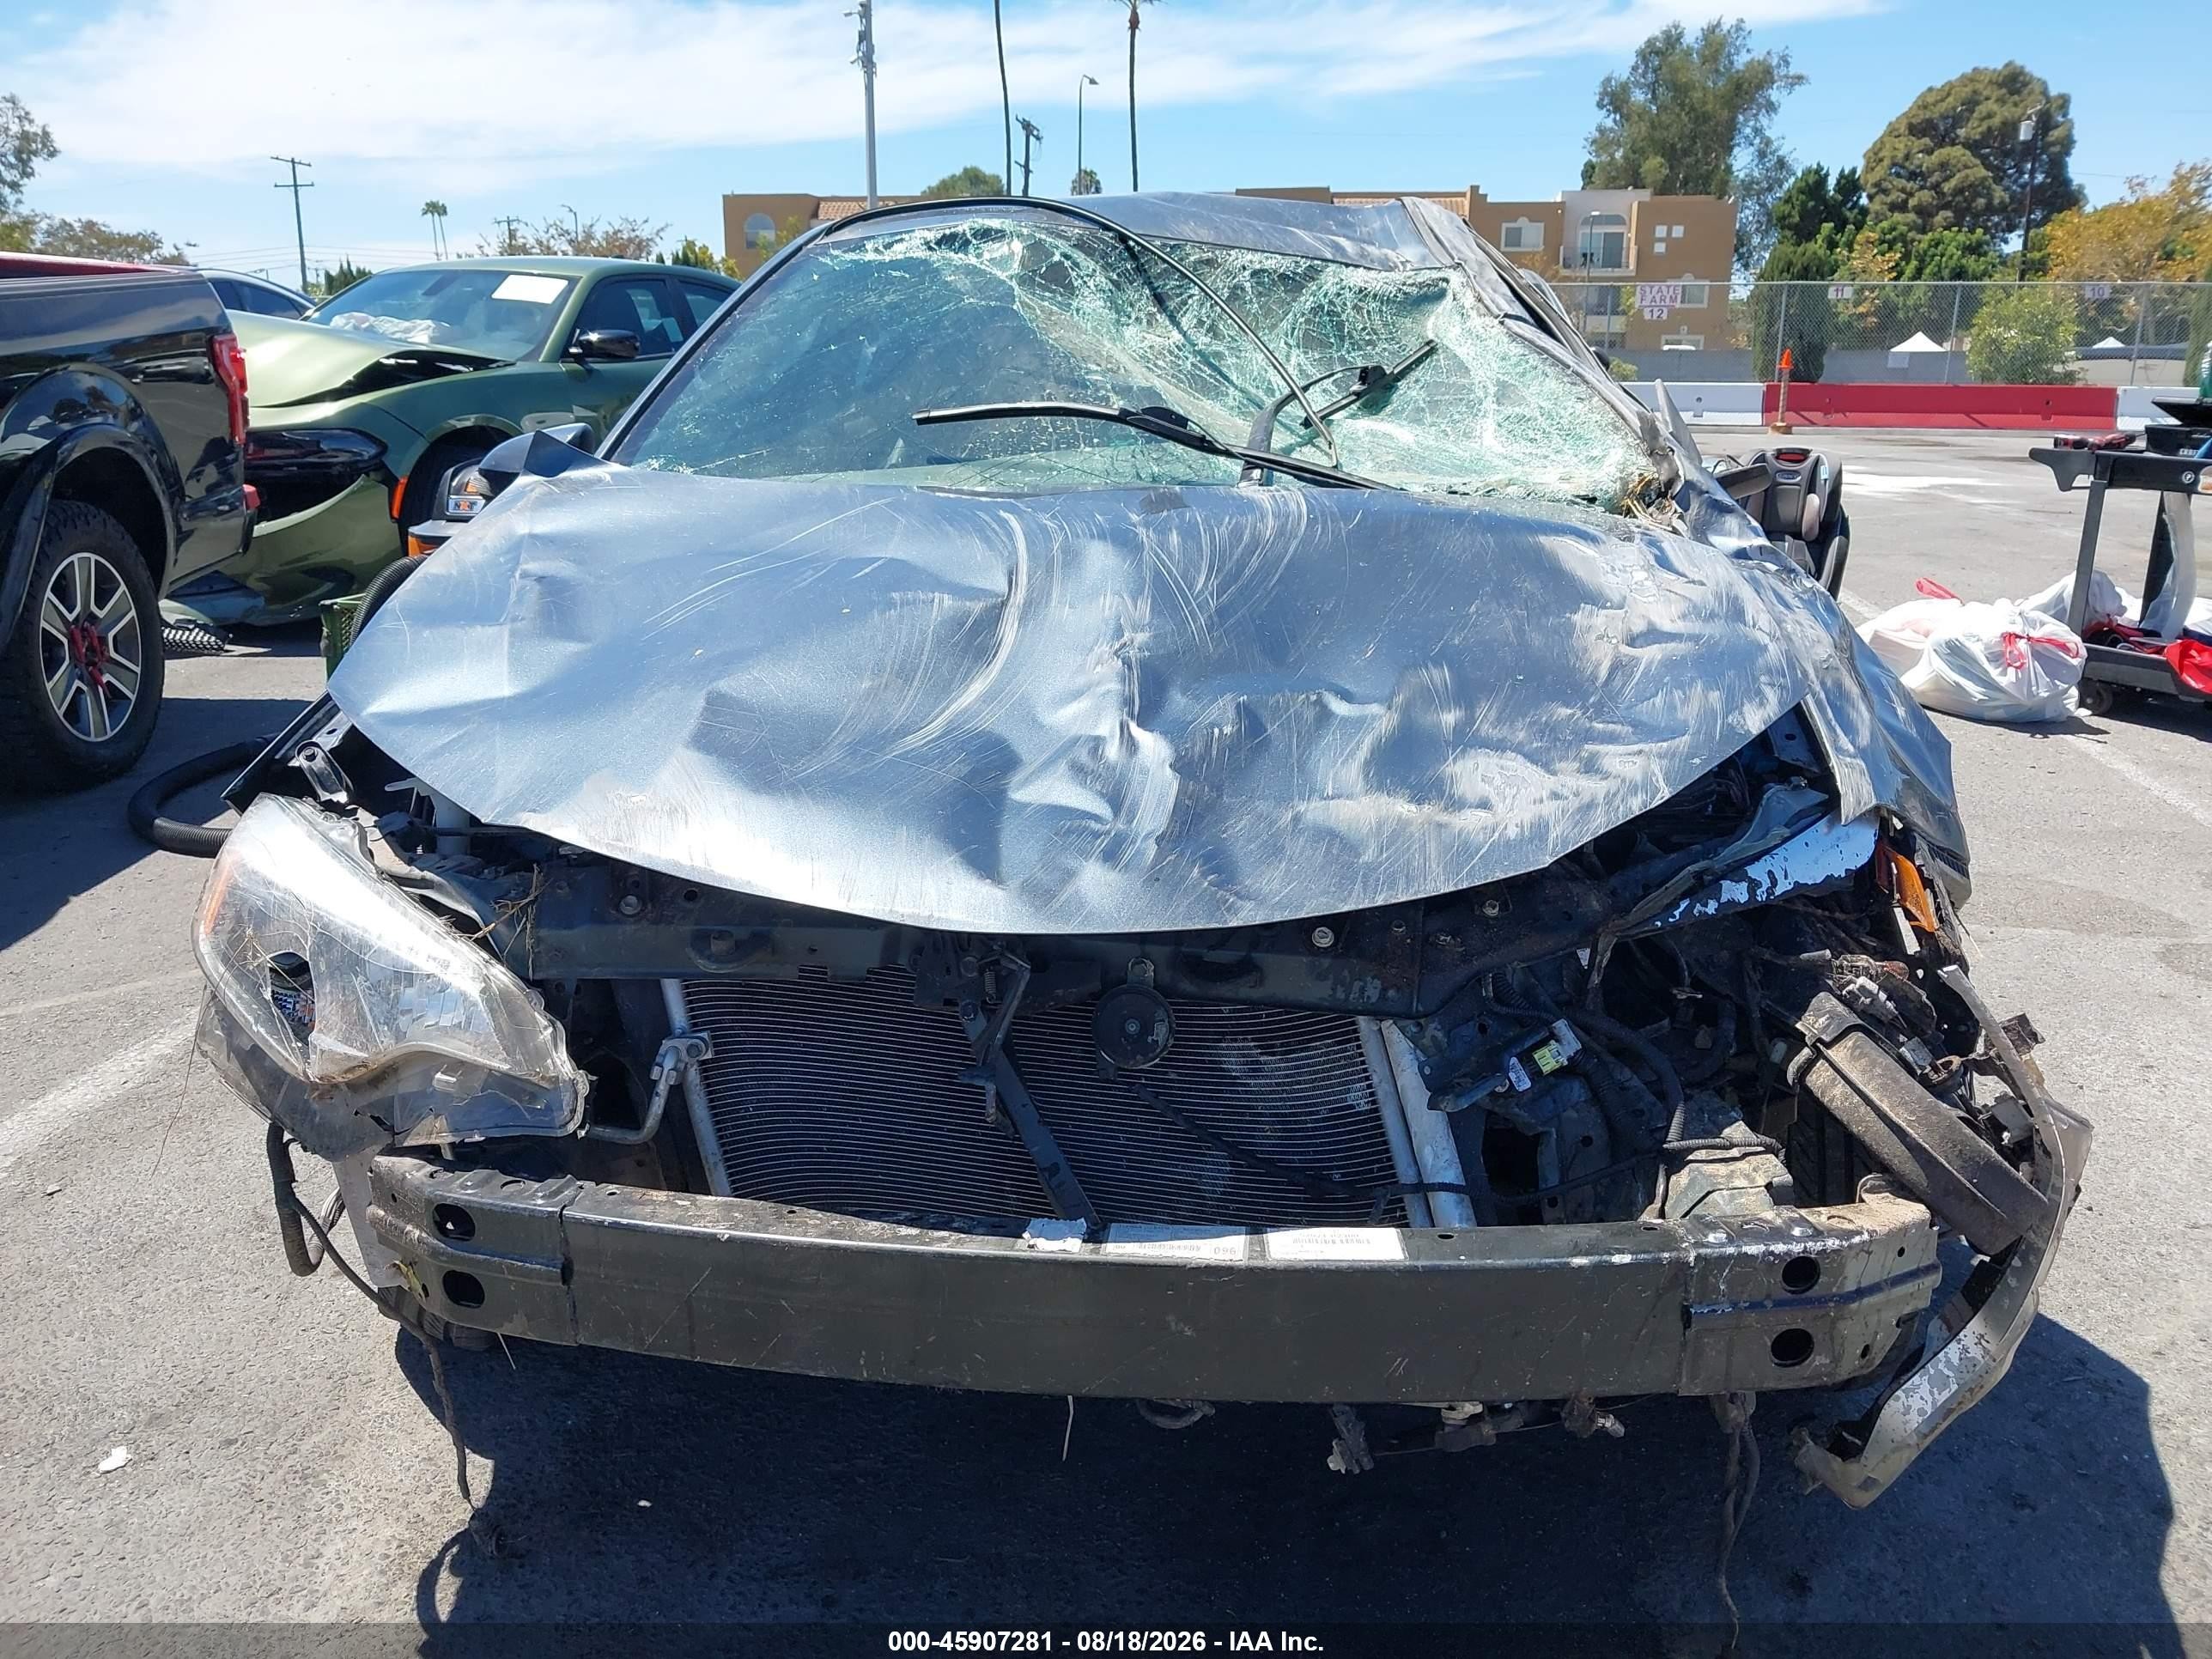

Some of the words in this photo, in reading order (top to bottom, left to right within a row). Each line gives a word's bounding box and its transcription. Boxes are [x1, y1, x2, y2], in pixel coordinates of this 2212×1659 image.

[1639, 285, 1680, 295] STATE
[2090, 287, 2106, 297] 10
[1640, 295, 1678, 304] FARM
[1649, 308, 1664, 319] 12
